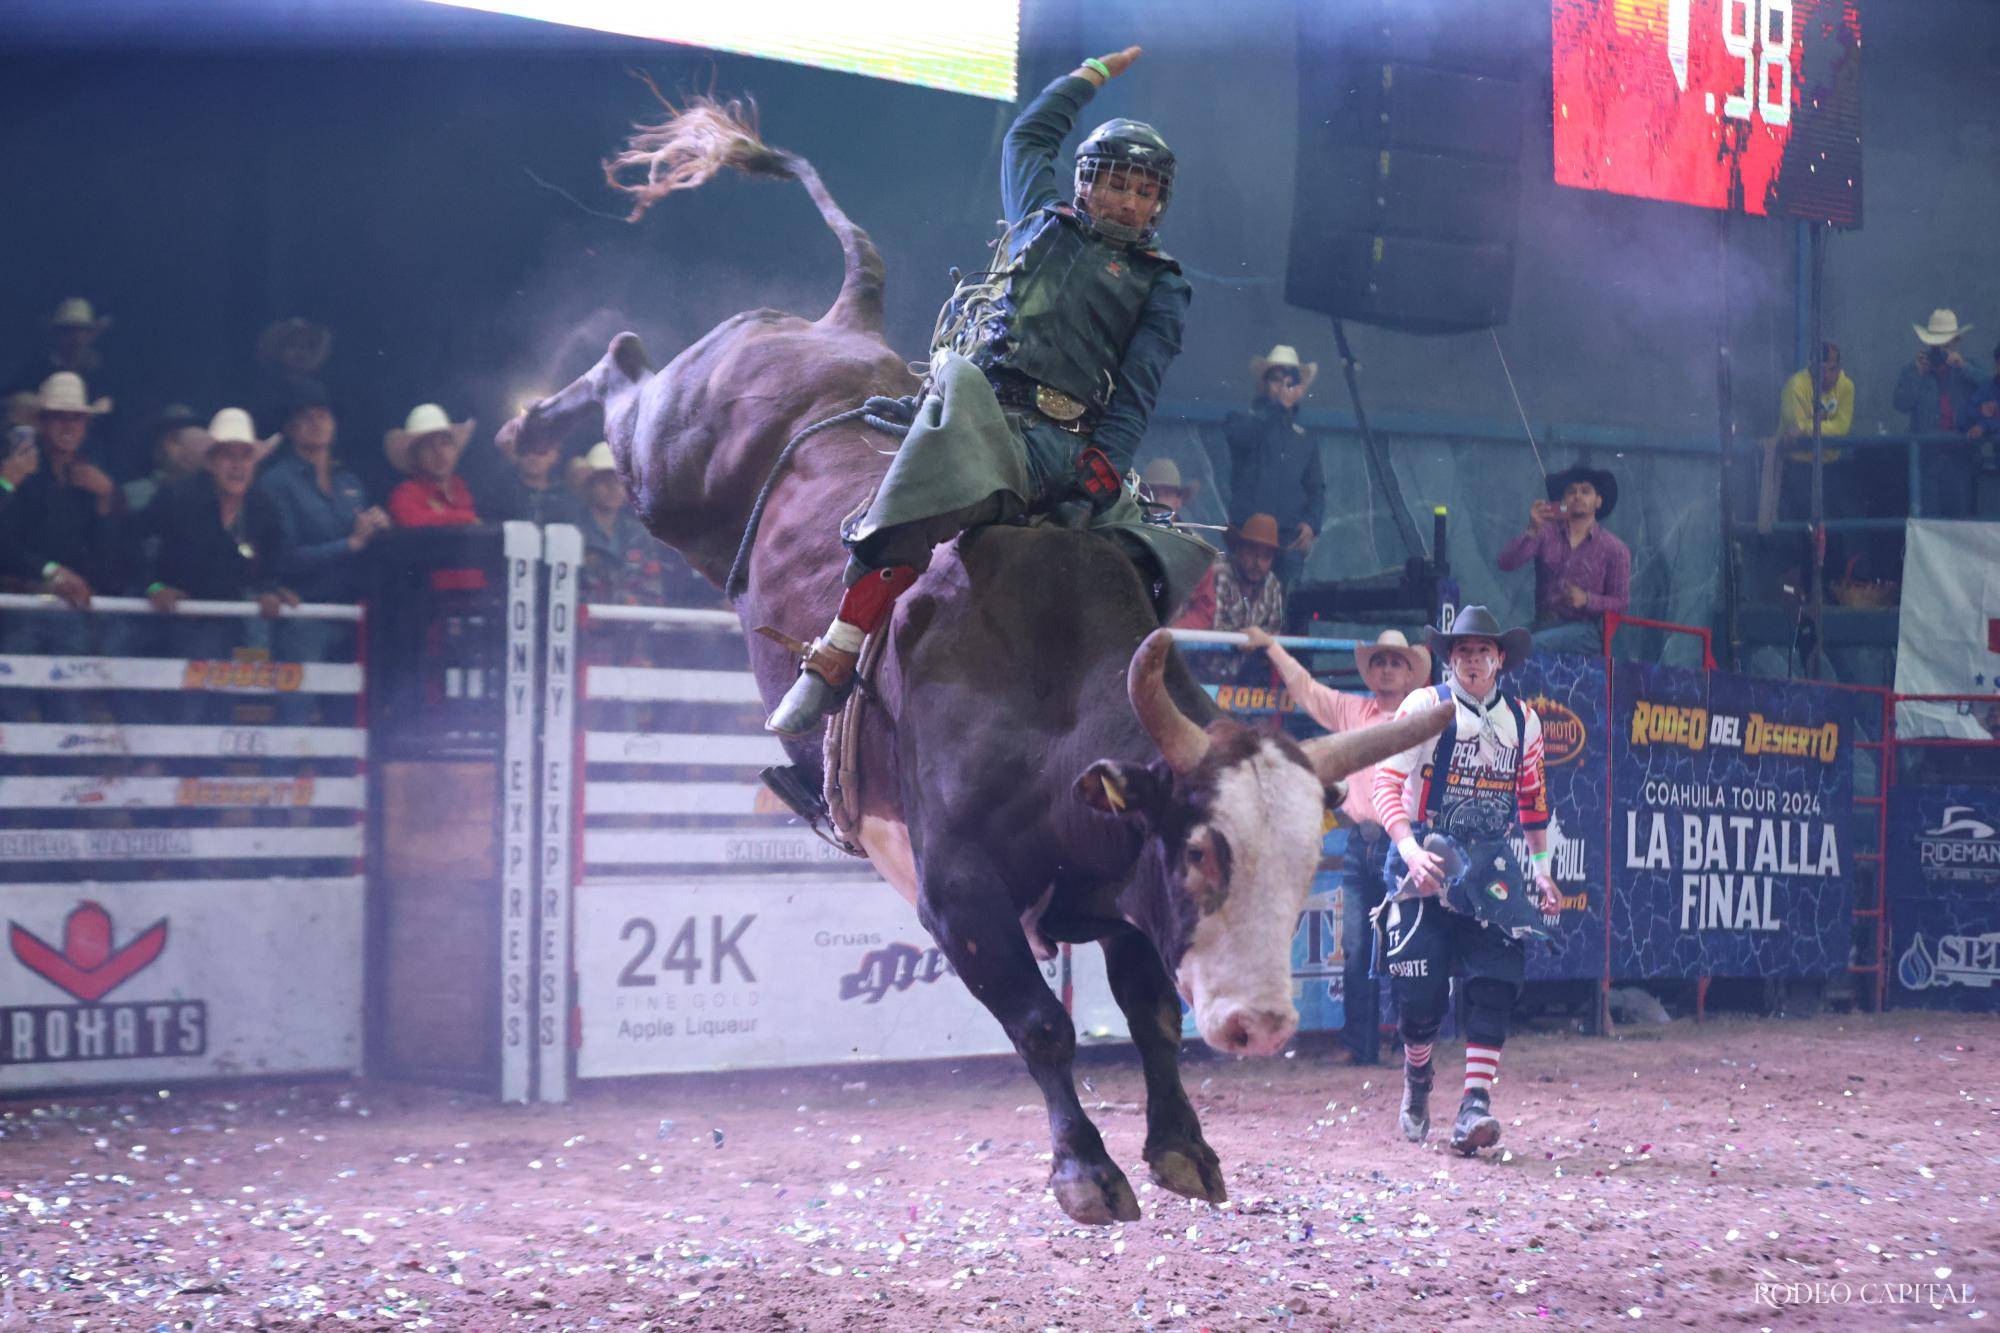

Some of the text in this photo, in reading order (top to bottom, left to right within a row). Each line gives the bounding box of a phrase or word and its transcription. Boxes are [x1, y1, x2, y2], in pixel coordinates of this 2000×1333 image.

[1632, 700, 1838, 763] RODEO DEL DESIERTO
[506, 558, 528, 1047] PONY EXPRESS
[541, 560, 568, 1047] PONY EXPRESS
[1645, 781, 1821, 816] COAHUILA TOUR 2024
[1557, 838, 1586, 880] BULL
[1626, 811, 1841, 877] LA BATALLA
[1680, 873, 1781, 931] FINAL
[618, 914, 758, 987] 24K
[815, 929, 882, 947] Gruas
[616, 992, 761, 1012] FINE GOLD
[618, 1015, 759, 1041] Apple Liqueur
[0, 1006, 203, 1061] ROHATS
